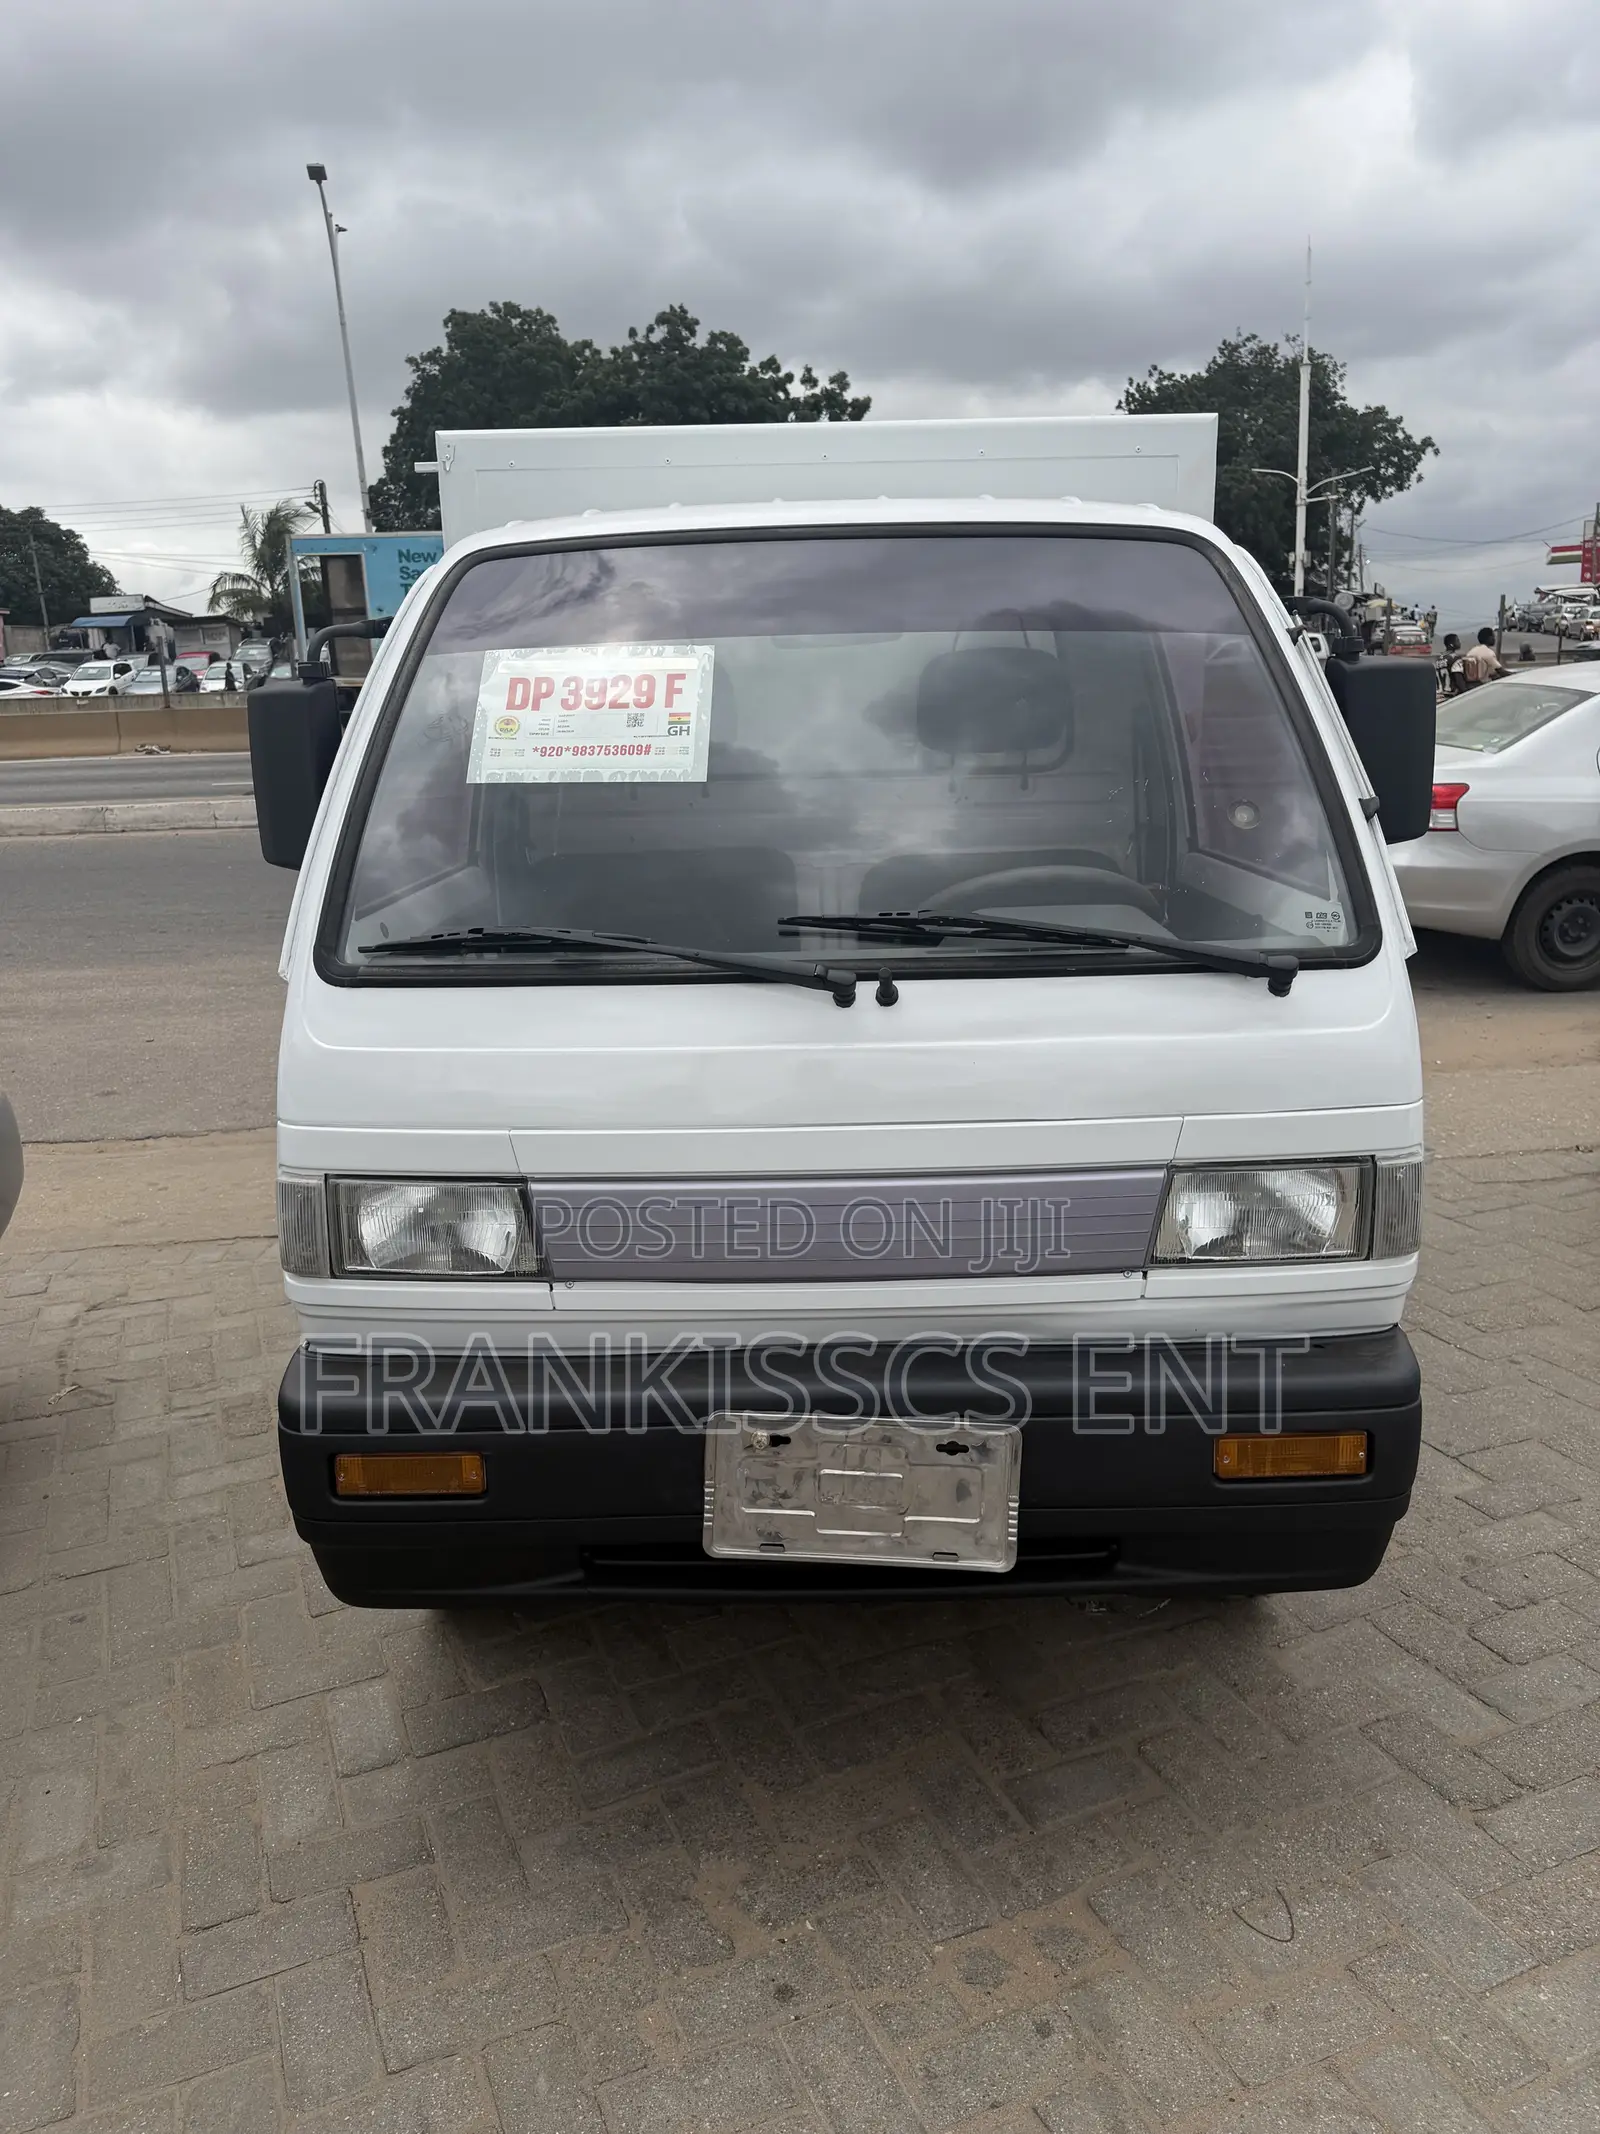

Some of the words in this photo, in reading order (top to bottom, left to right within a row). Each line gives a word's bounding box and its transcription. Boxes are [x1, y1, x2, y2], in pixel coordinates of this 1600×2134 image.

[397, 549, 437, 563] New
[506, 676, 555, 712] DP
[560, 673, 656, 711] 3929
[664, 673, 687, 708] F
[667, 725, 691, 737] GH
